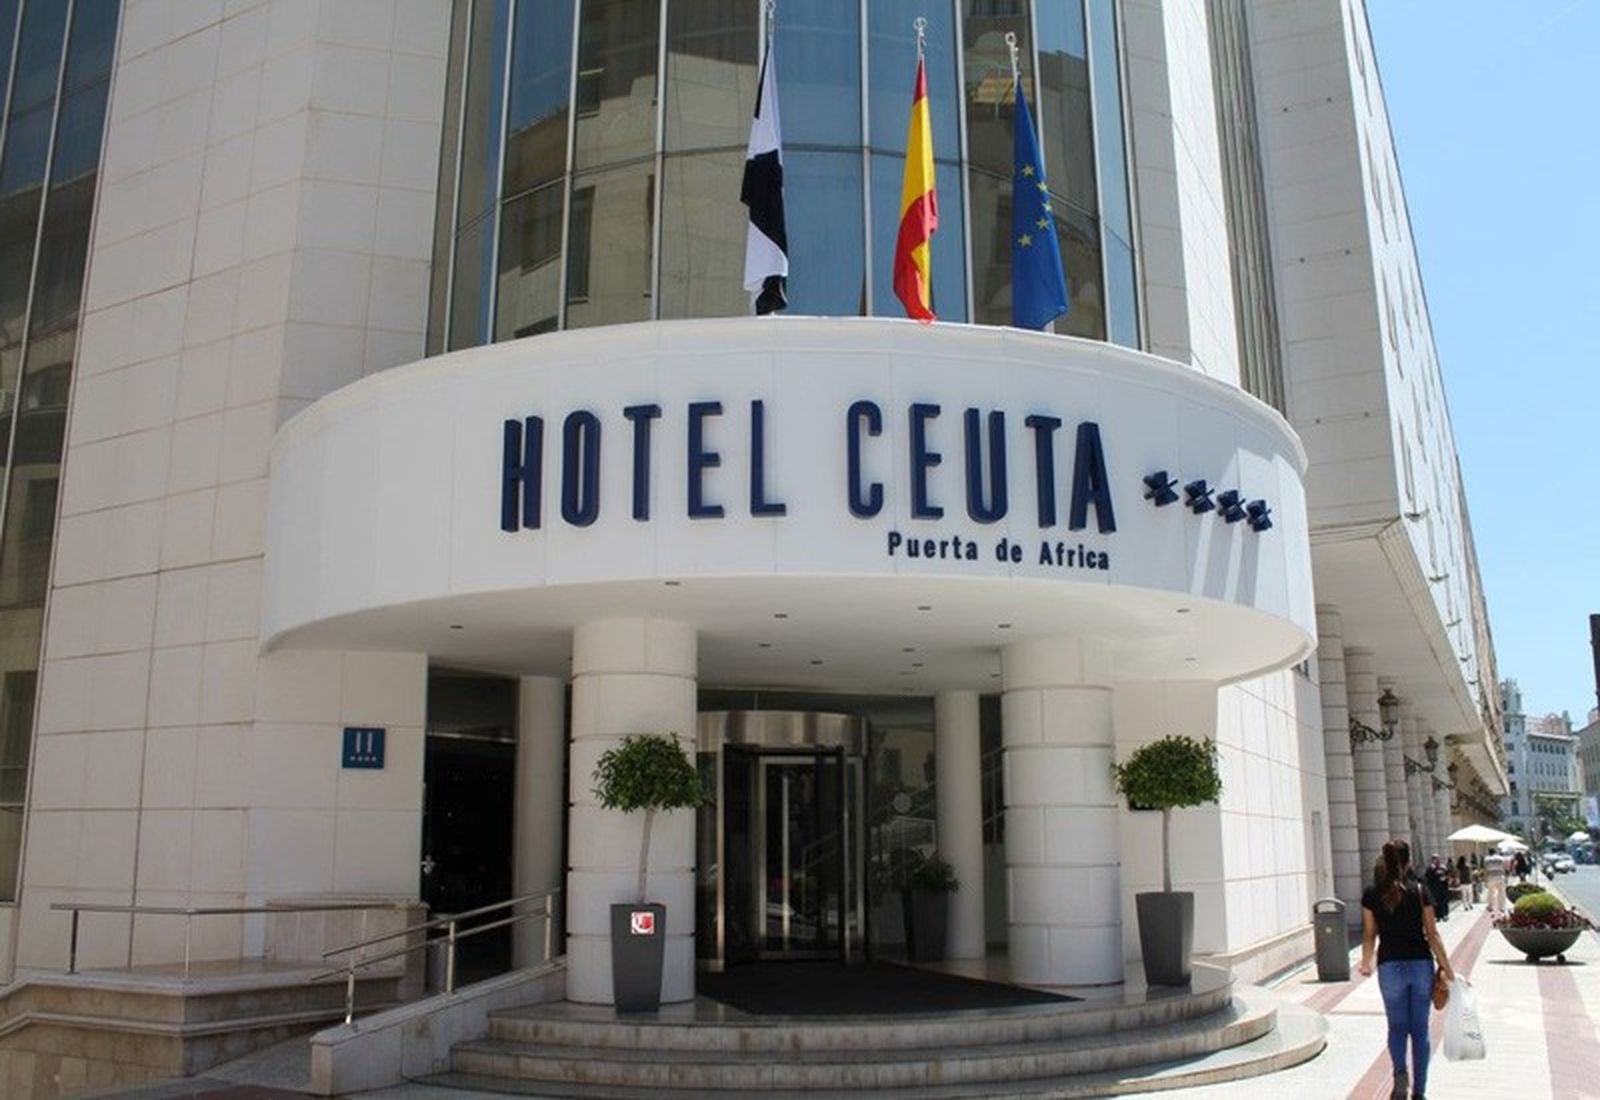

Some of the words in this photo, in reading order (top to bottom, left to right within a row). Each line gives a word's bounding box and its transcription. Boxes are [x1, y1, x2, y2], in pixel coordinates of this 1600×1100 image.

[500, 399, 787, 533] HOTEL
[847, 400, 1116, 533] CEUTA
[887, 531, 978, 561] Puerta
[995, 538, 1022, 563] de
[1039, 541, 1109, 570] Africa
